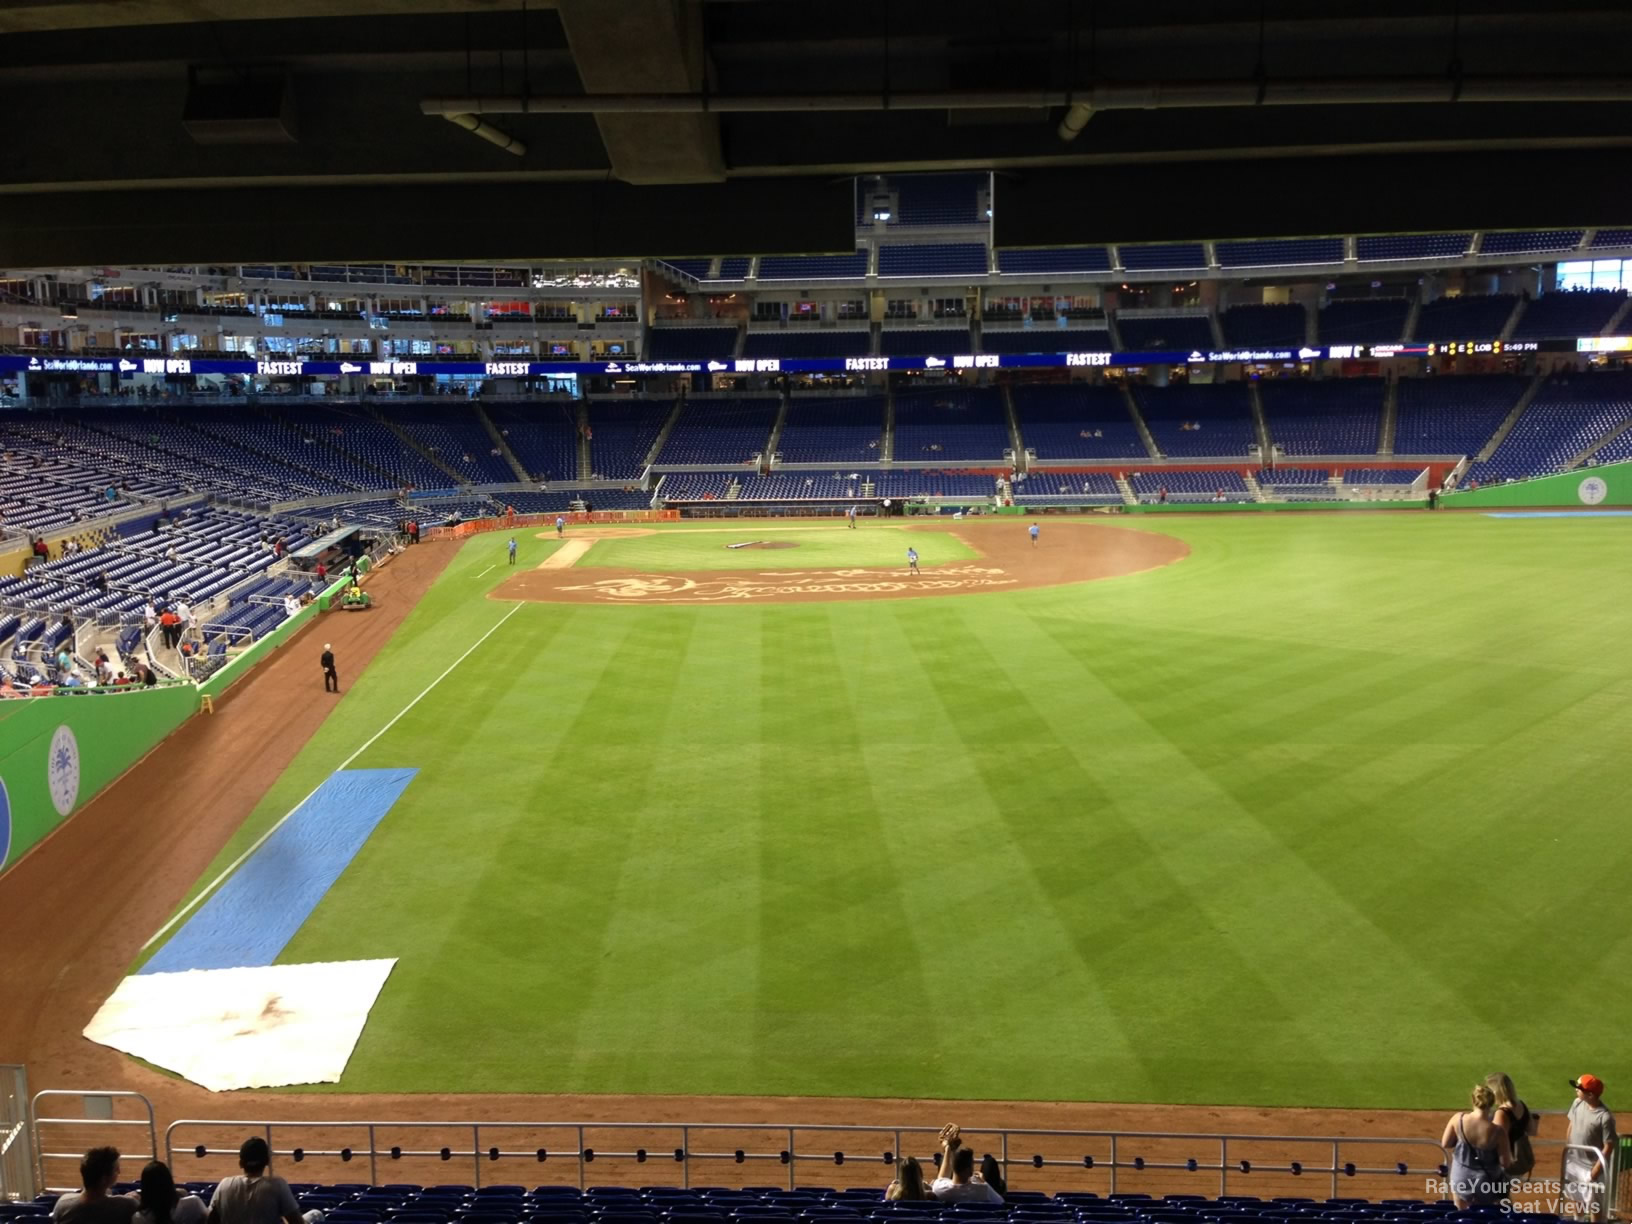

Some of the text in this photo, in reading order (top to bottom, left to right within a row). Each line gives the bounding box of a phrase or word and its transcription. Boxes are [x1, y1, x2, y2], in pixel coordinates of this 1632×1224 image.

[1329, 346, 1353, 358] NOW
[1440, 345, 1448, 353] H
[1458, 344, 1466, 352] E
[1474, 343, 1493, 351] LOB
[1503, 343, 1523, 351] 5:49
[1524, 342, 1538, 350] PM
[953, 355, 999, 368] NOW OPEN
[1066, 353, 1112, 366] FASTEST
[1209, 351, 1291, 361] SeaWorldOrlando.com
[143, 359, 191, 373] NOW OPEN
[257, 362, 303, 374] FASTEST
[370, 362, 417, 374] NOW OPEN
[485, 362, 530, 374] FASTEST
[625, 363, 701, 373] SeaWorldOrlando.com
[735, 360, 780, 371] NOW OPEN
[845, 358, 889, 370] FASTEST
